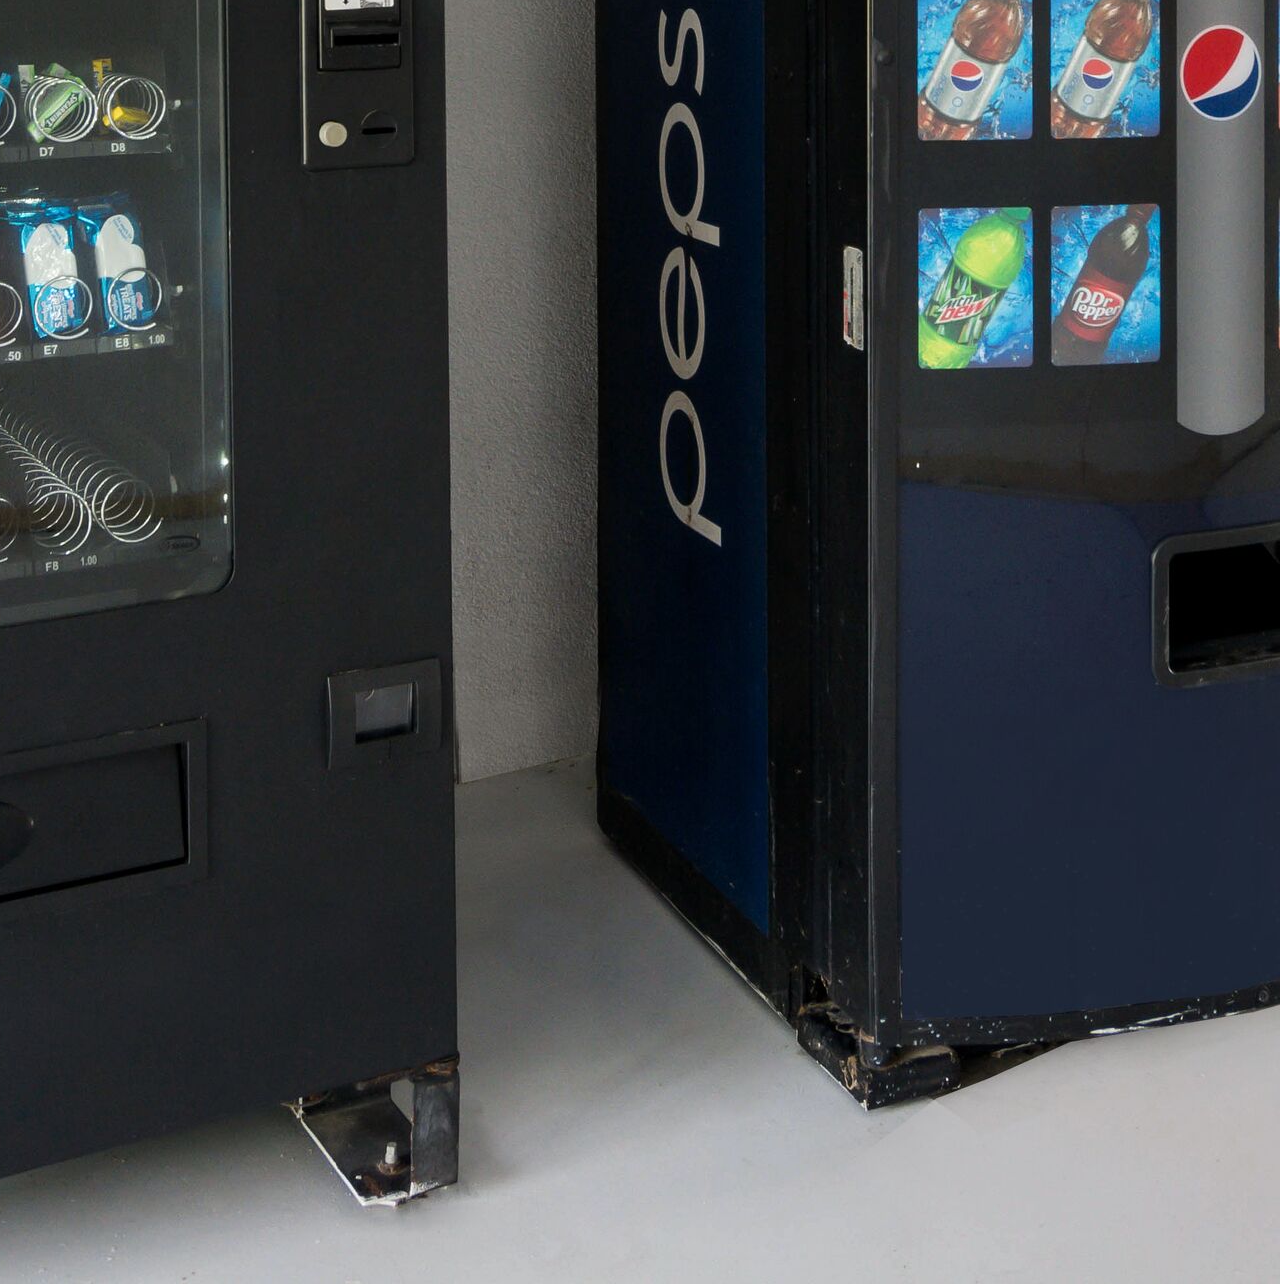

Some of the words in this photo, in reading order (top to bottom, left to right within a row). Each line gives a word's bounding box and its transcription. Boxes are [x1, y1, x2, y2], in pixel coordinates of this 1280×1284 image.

[39, 146, 54, 157] D7
[111, 143, 126, 153] D8
[1072, 287, 1120, 320] Pepper
[1092, 291, 1113, 306] Dr
[115, 338, 130, 348] E8
[148, 334, 166, 344] 1.00
[44, 344, 58, 355] E7
[5, 351, 22, 361] .50
[80, 555, 98, 567] 1.00
